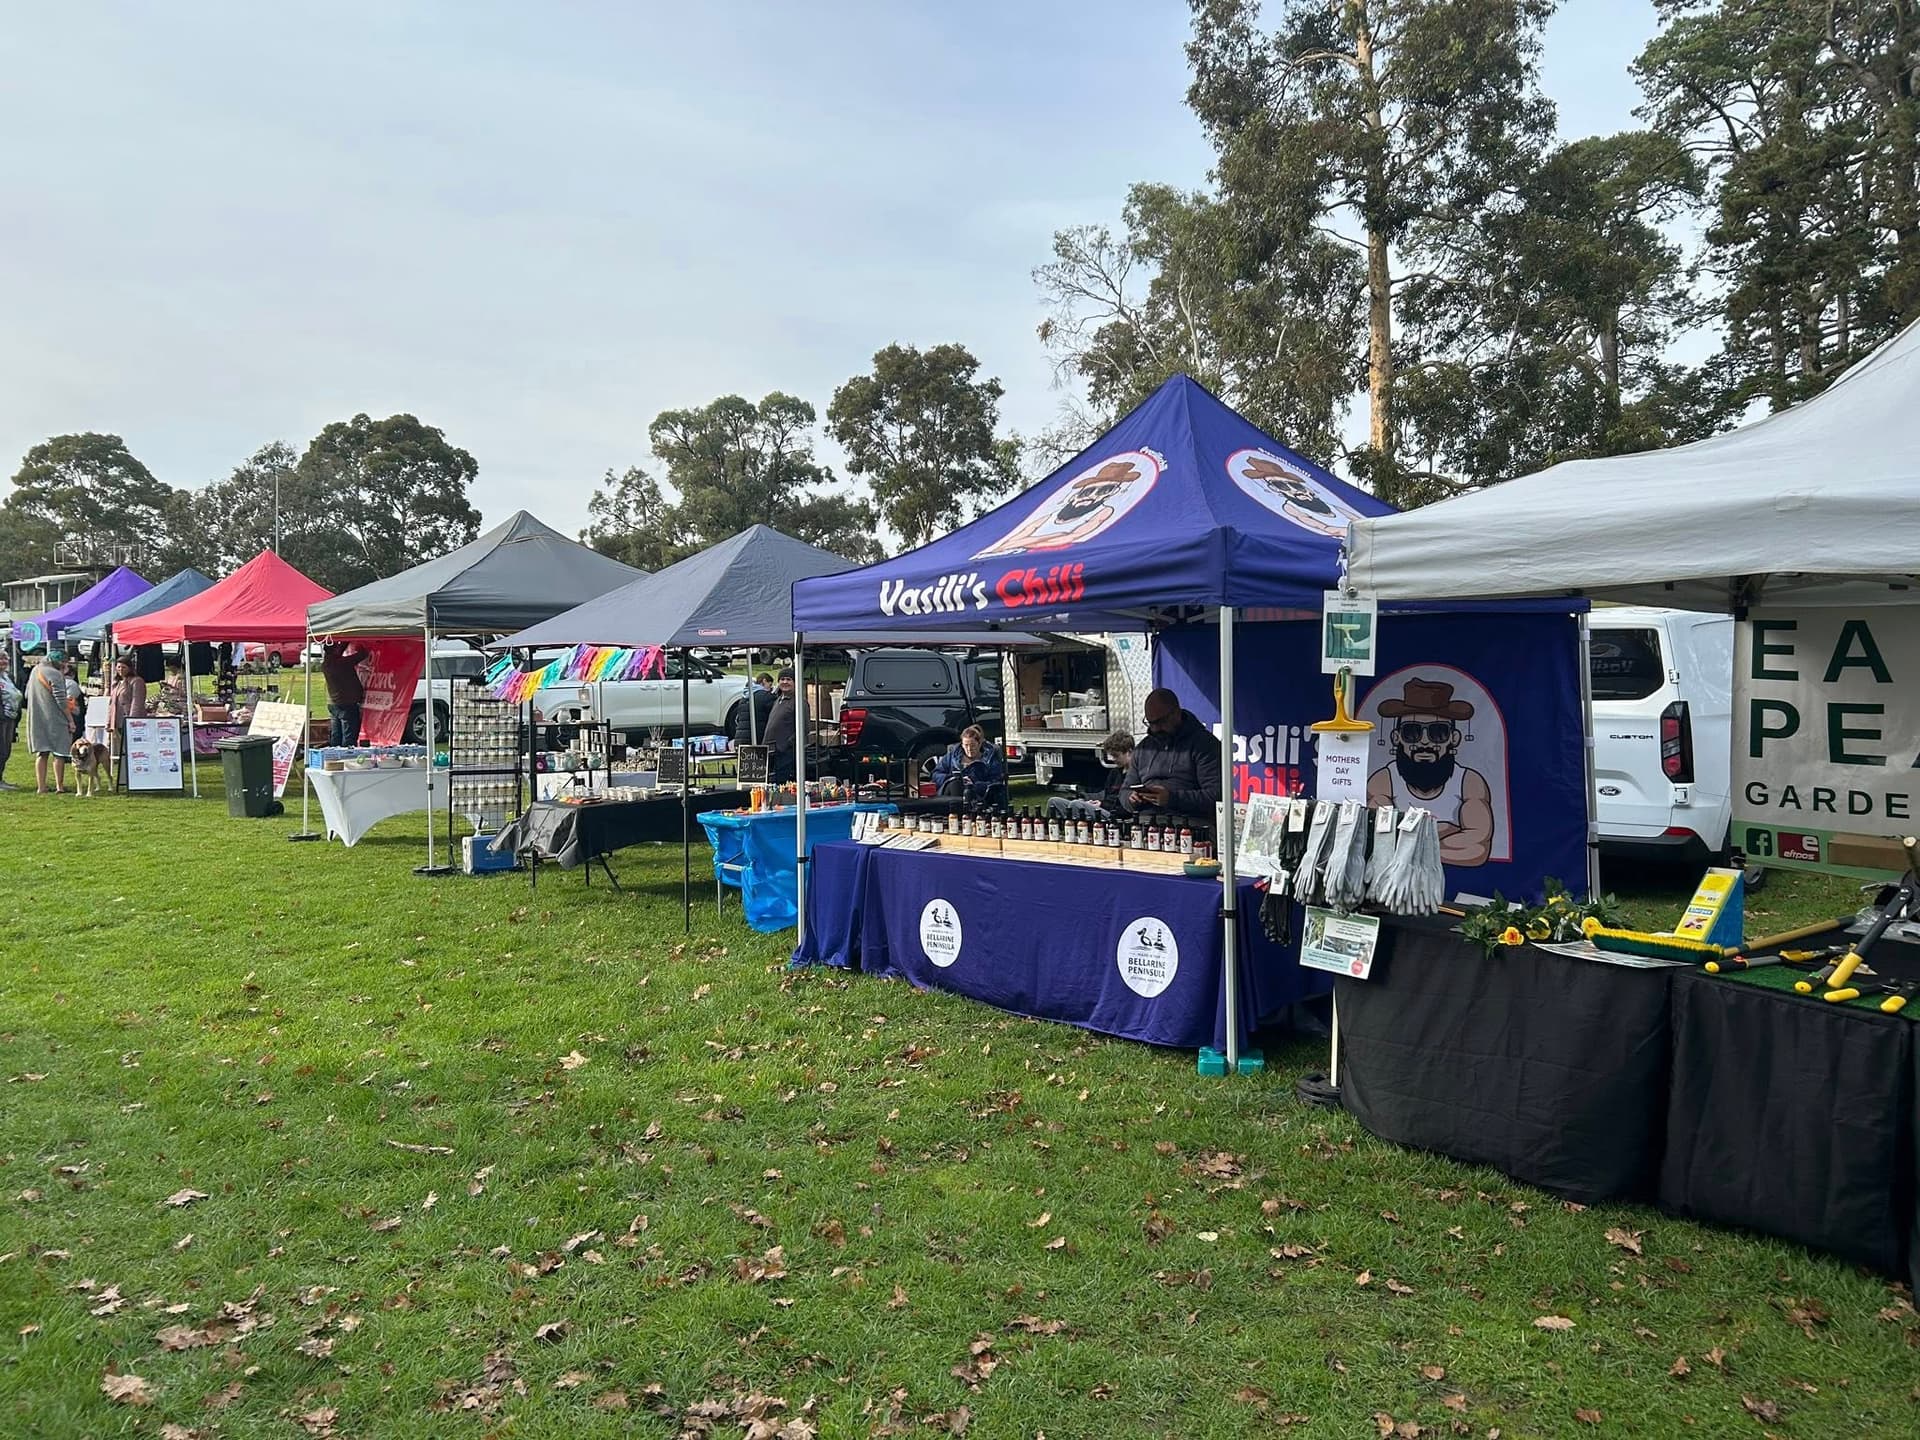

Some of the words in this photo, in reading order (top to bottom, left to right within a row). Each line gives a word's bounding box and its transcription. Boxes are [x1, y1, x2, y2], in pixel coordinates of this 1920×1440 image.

[879, 572, 988, 616] Vasili's
[995, 562, 1085, 608] Chili
[1749, 698, 1920, 767] PE
[1325, 755, 1361, 764] MOTHERS
[1331, 777, 1352, 786] GIFTS
[1745, 781, 1910, 819] GARDE
[1783, 850, 1815, 860] eftpos
[926, 933, 954, 943] BELLARINE
[926, 941, 955, 950] PENINSULA
[1128, 957, 1166, 969] BELLARINE
[1128, 966, 1166, 978] PENINSULA
